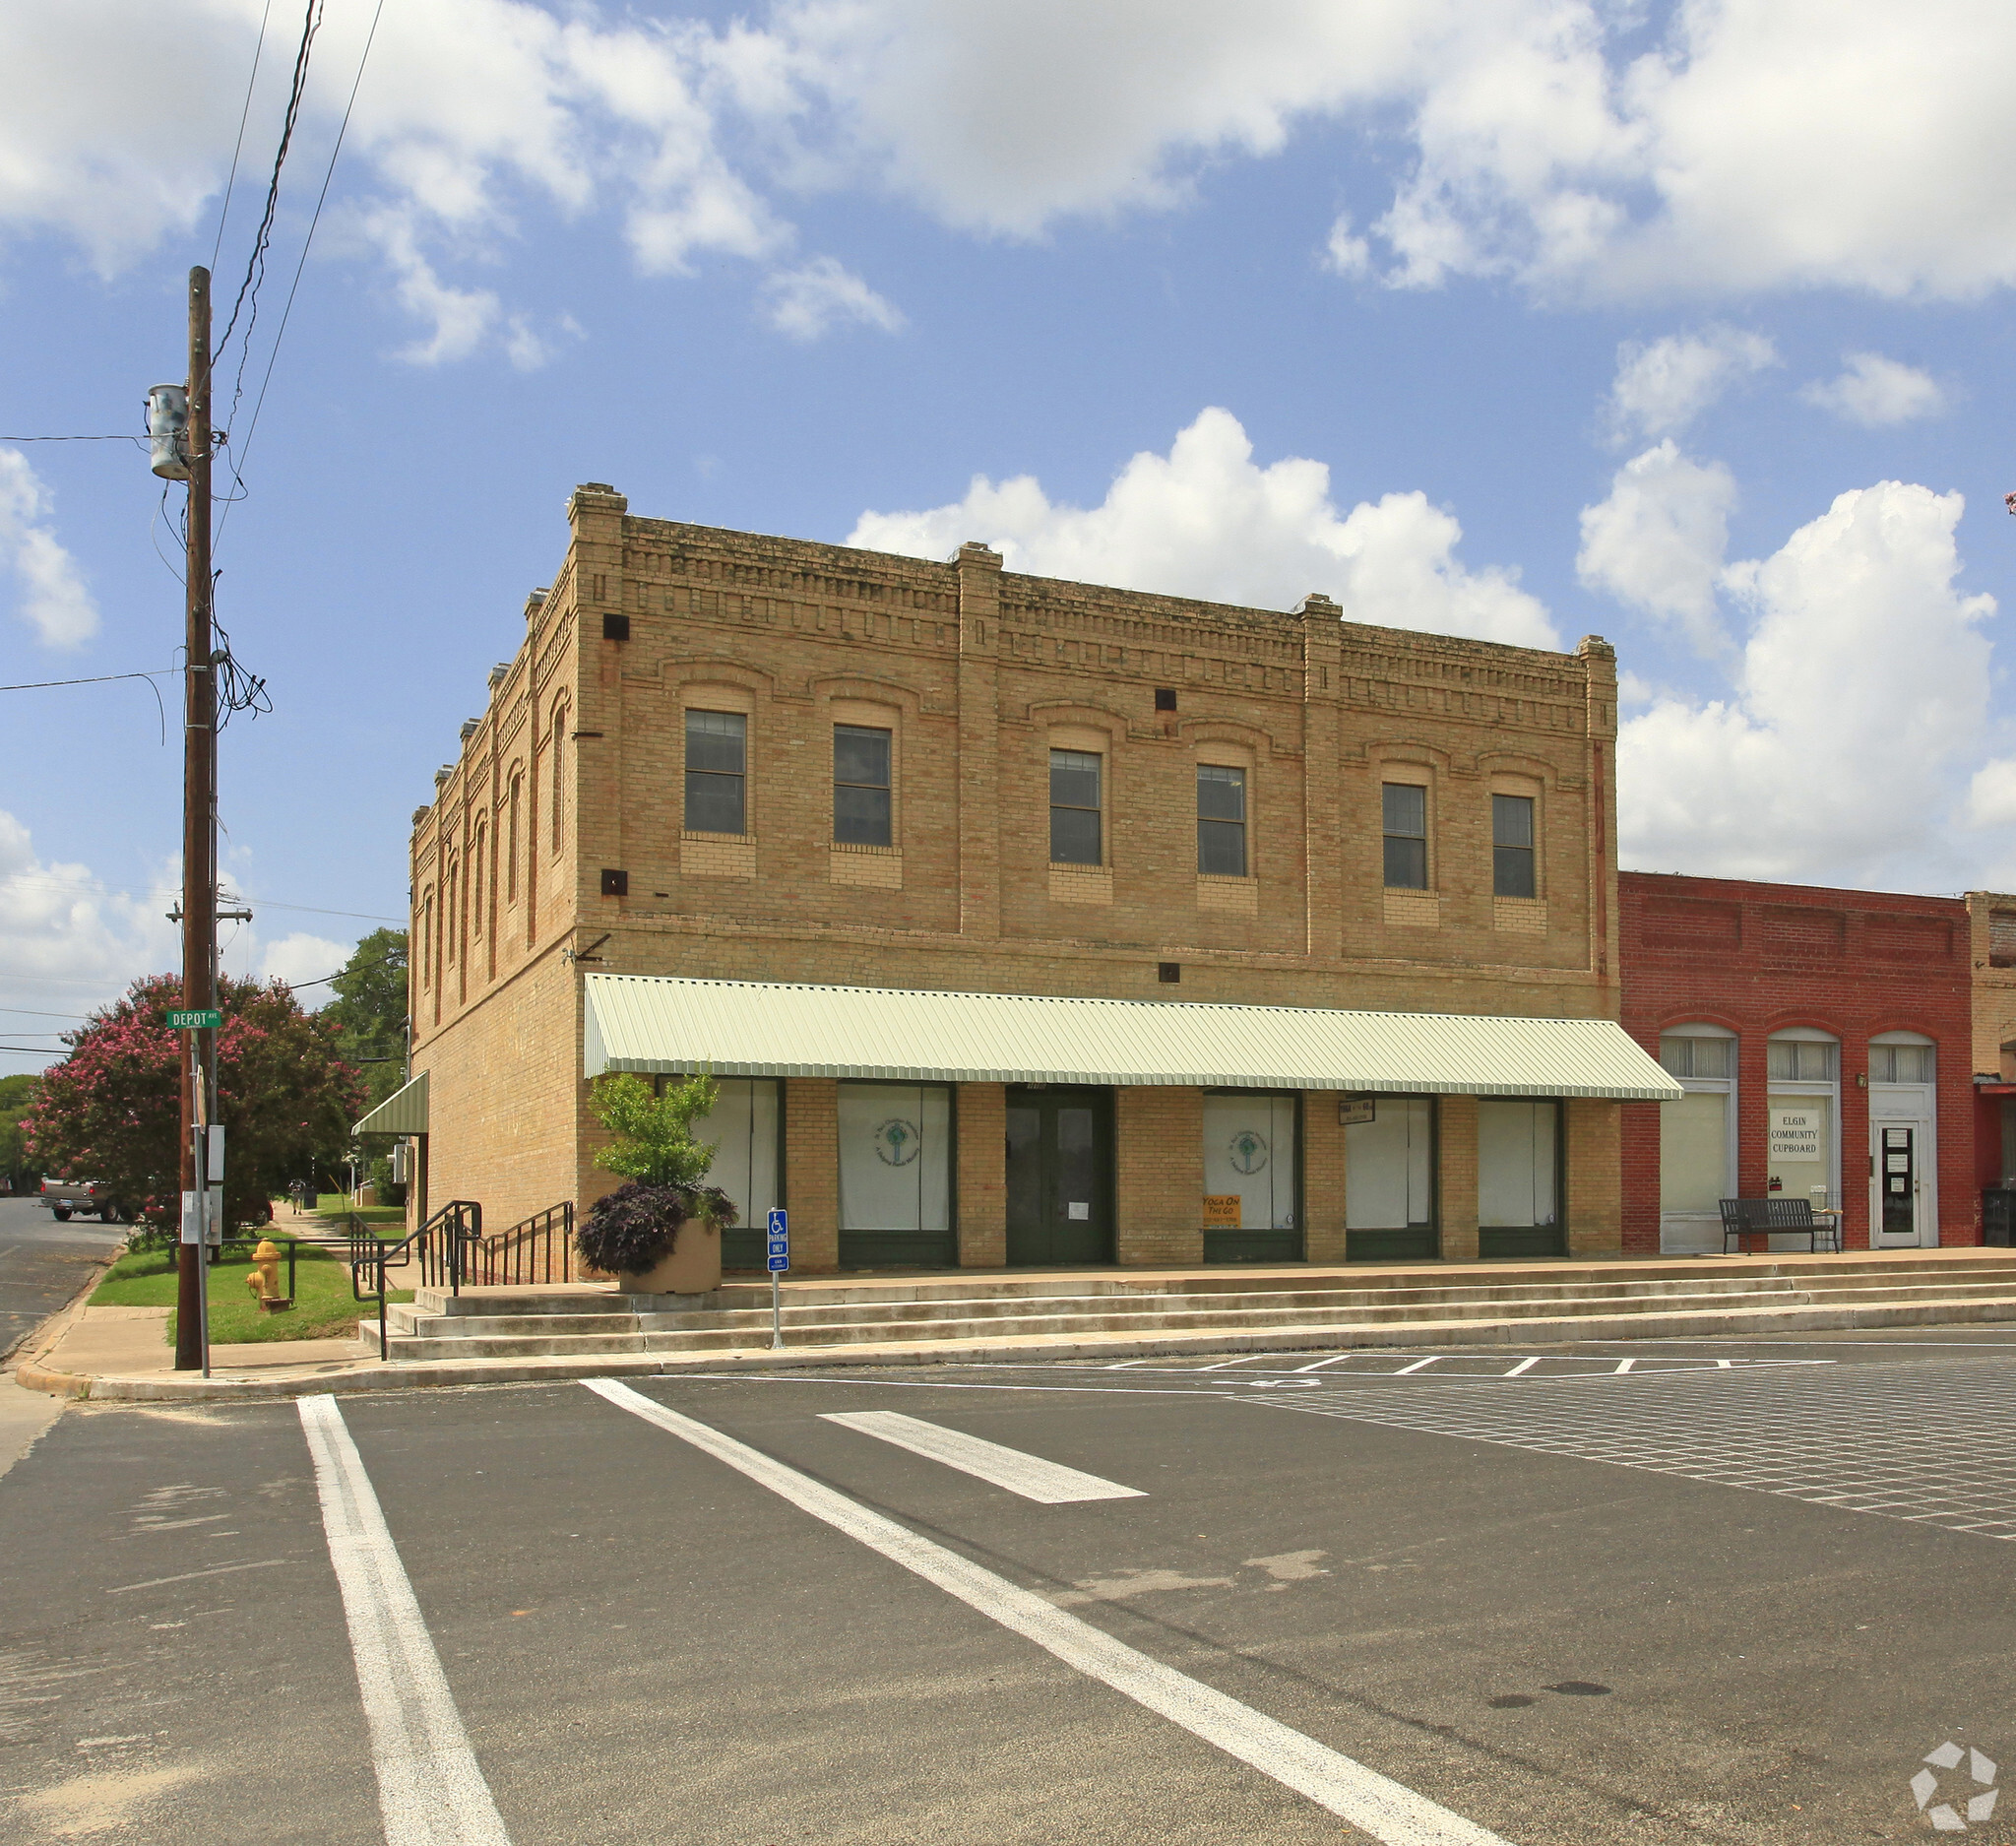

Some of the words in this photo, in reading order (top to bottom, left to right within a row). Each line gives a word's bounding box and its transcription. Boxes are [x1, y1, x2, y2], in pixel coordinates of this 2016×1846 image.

[173, 1013, 206, 1025] DEPOT
[1783, 1116, 1806, 1125] ELGIN
[1771, 1129, 1818, 1139] COMMUNITY
[1773, 1143, 1816, 1153] CUPBOARD
[1202, 1197, 1225, 1206] YOGA
[1227, 1197, 1240, 1206] ON
[773, 1243, 784, 1252] ONLY
